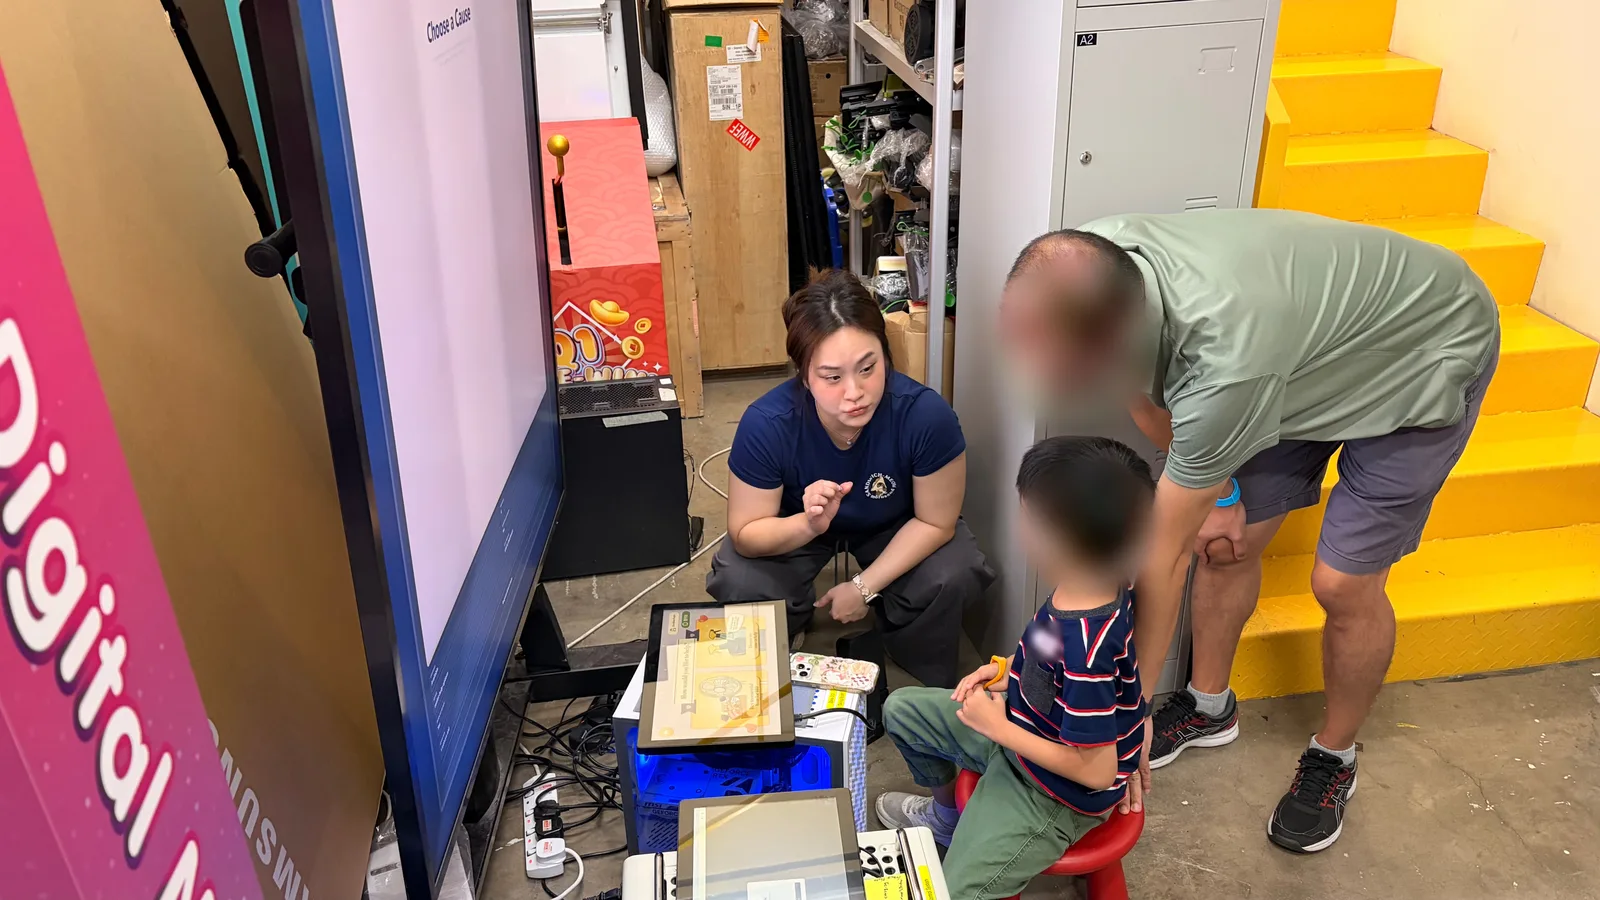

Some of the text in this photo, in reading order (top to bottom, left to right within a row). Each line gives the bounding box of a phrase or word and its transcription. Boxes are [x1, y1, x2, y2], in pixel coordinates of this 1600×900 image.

[426, 7, 471, 43] Choose a Cause
[1079, 34, 1094, 46] A2
[728, 122, 757, 149] WWEF
[207, 718, 310, 900] MSUN
[652, 809, 679, 817] GEFORC
